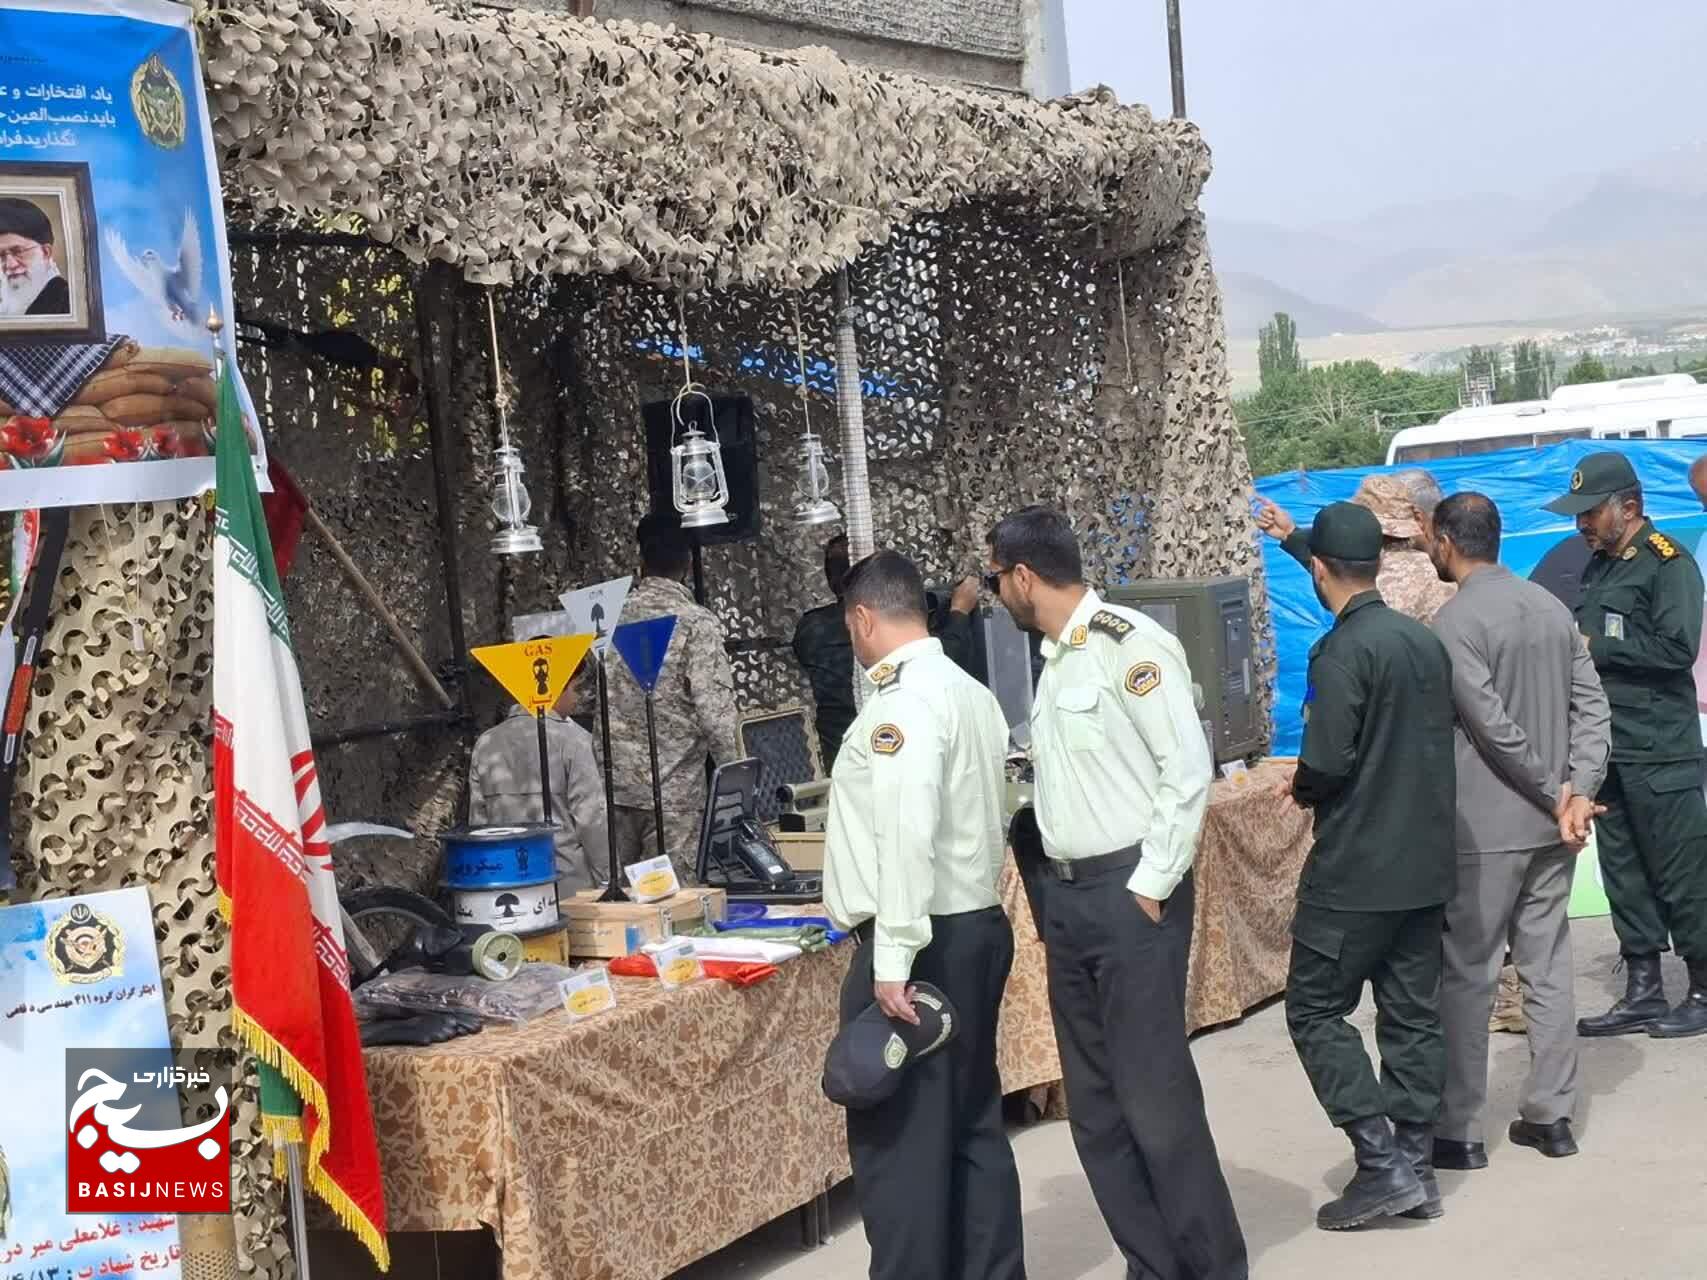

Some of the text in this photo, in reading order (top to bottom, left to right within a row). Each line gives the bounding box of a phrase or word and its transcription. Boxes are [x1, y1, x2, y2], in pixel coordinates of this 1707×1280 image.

[12, 87, 21, 99] و
[25, 83, 87, 101] افتخارات
[524, 644, 553, 657] GAS
[59, 1221, 122, 1252] غلامعلی
